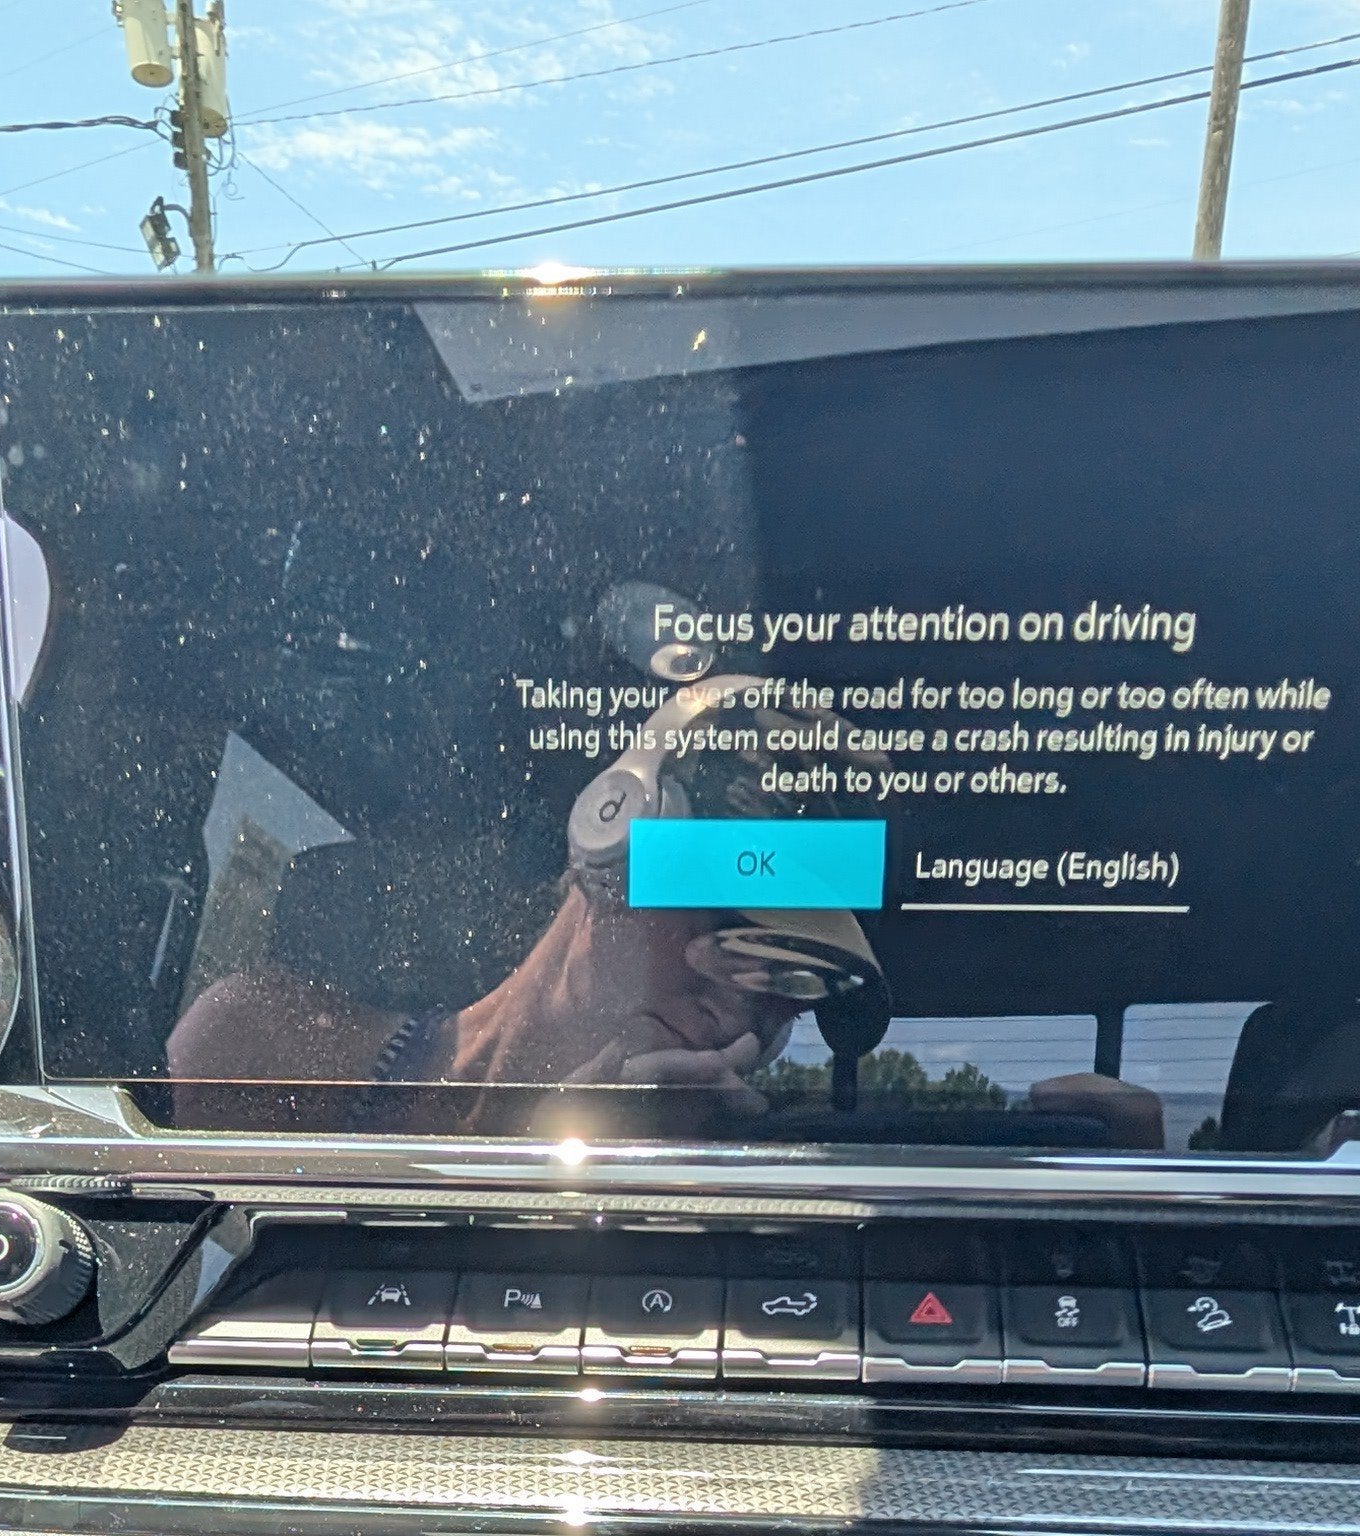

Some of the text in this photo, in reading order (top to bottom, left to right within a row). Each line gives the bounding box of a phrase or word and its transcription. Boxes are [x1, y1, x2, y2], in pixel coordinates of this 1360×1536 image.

[654, 599, 1196, 653] Focus your attention on driving
[515, 677, 1332, 718] Taking your eyes off the road for too long or too often while
[529, 720, 1315, 761] using this system could cause a crash resulting in injury or
[761, 762, 1067, 801] death to you or others.
[736, 850, 776, 877] OK
[915, 850, 1179, 888] Language (English)
